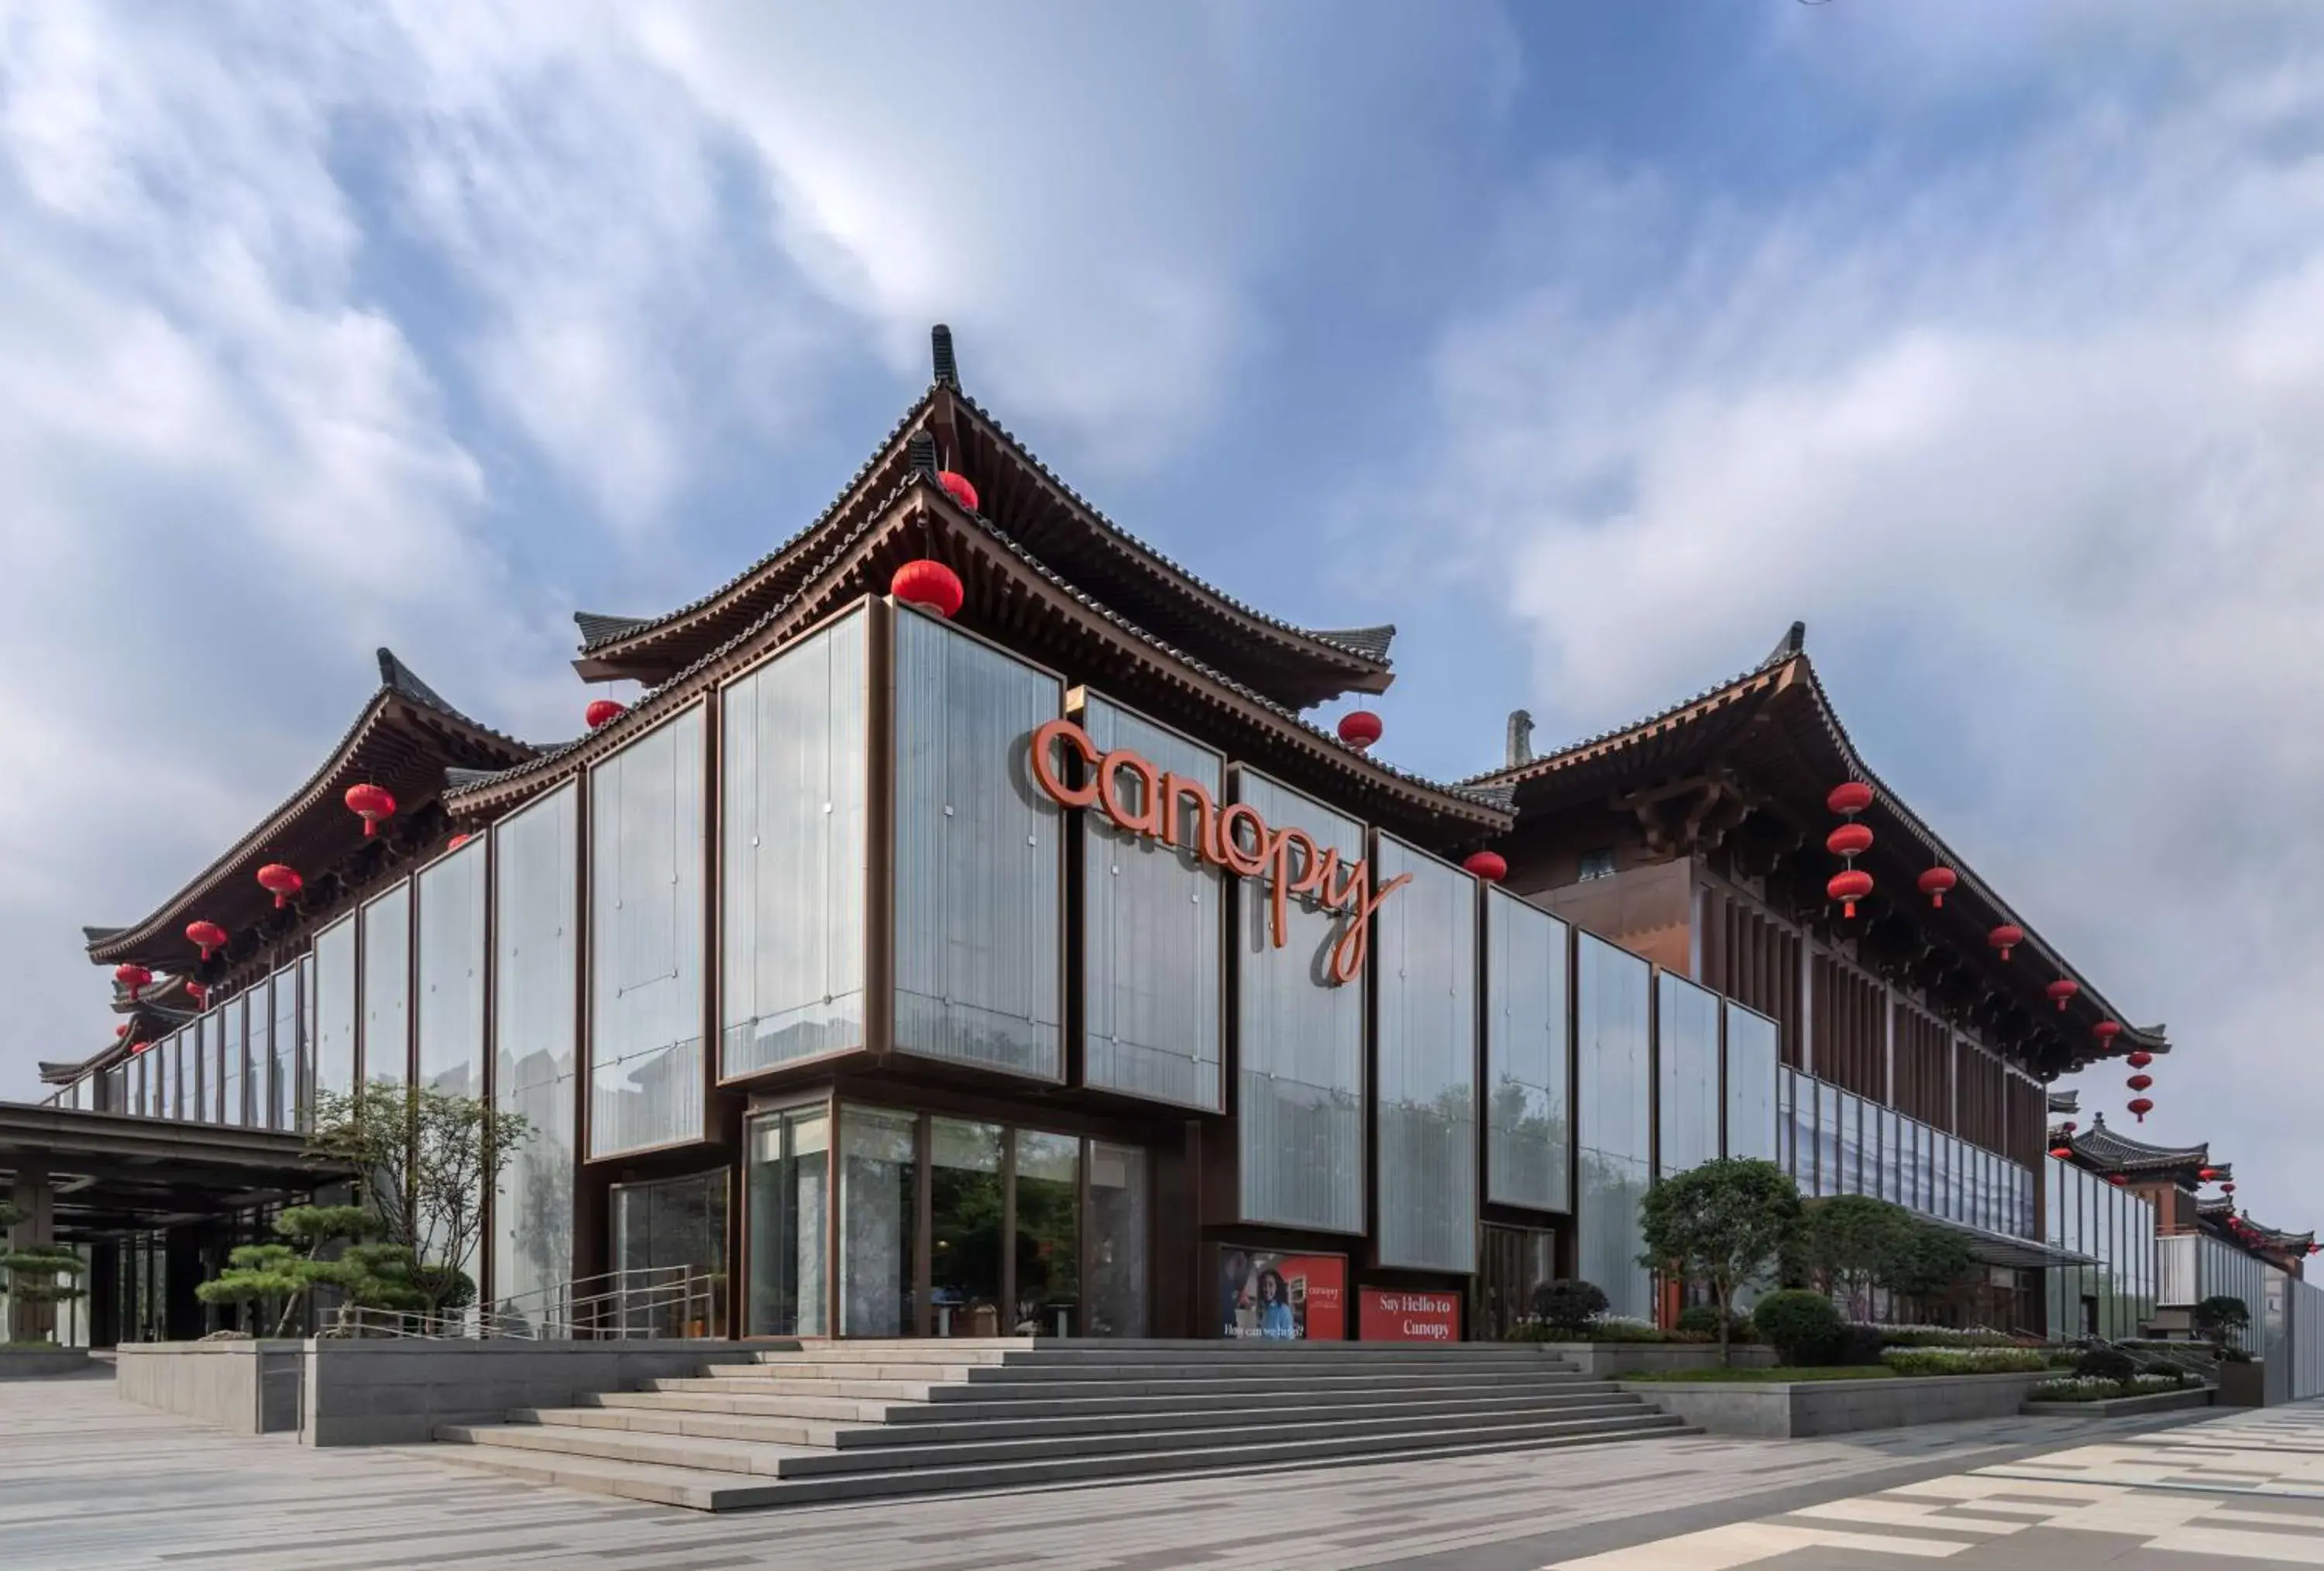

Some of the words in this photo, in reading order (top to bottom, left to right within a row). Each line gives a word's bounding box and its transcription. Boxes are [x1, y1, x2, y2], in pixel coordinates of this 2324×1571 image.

[1031, 718, 1414, 985] canopy
[1380, 1294, 1397, 1315] Say
[1402, 1295, 1435, 1312] Hello
[1437, 1301, 1450, 1313] to
[1224, 1323, 1243, 1336] How
[1244, 1328, 1262, 1336] can
[1403, 1318, 1449, 1339] Canopy
